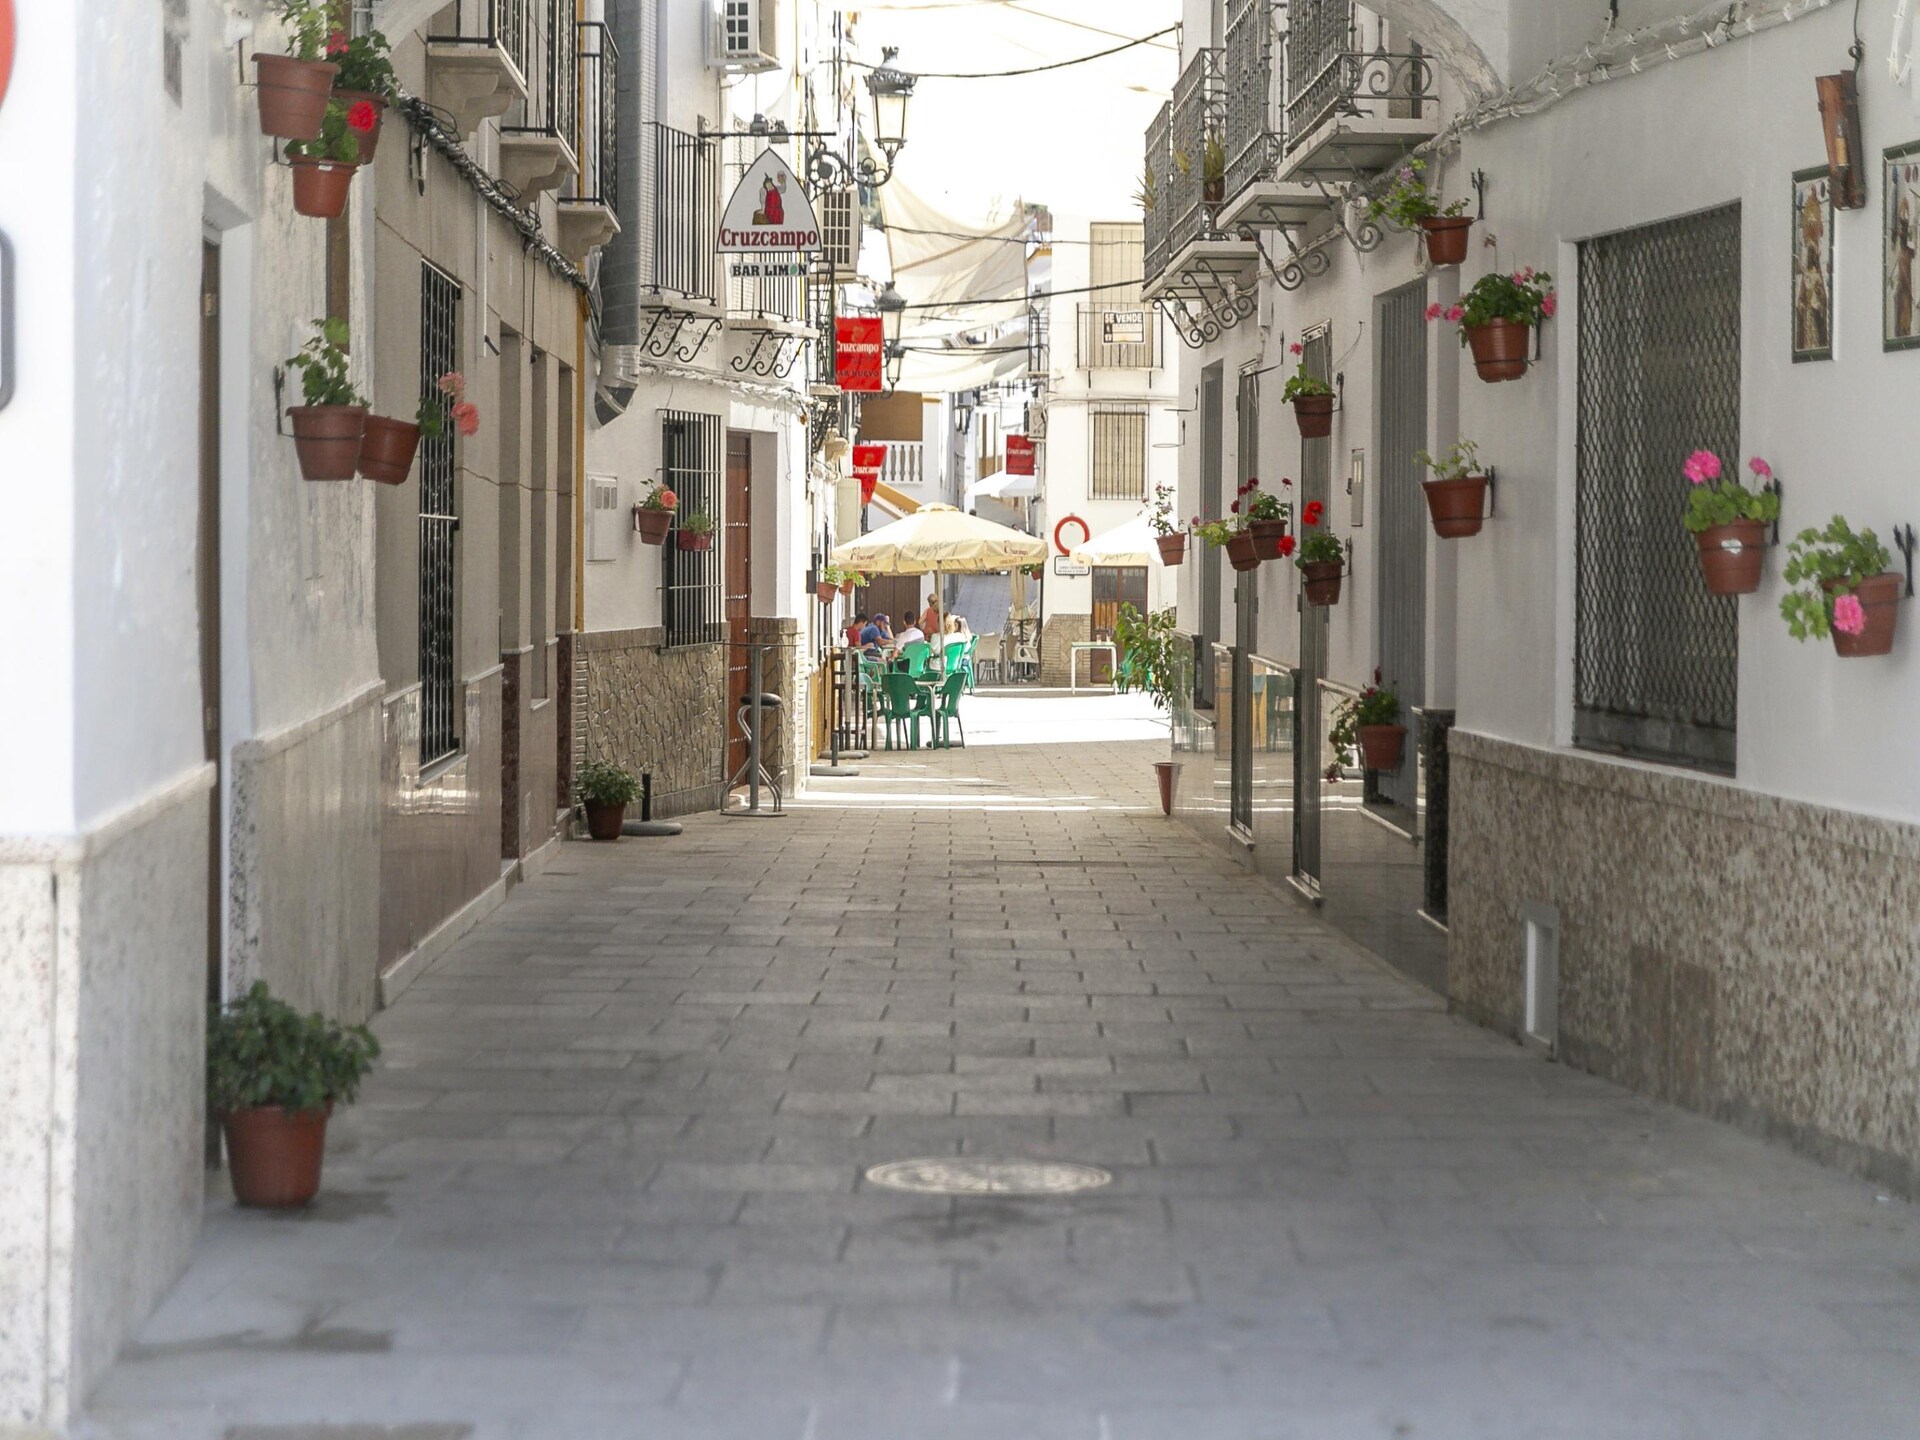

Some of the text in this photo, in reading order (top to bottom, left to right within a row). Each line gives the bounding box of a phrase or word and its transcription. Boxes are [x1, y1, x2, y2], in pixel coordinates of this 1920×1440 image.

[721, 228, 817, 250] Cruzcampo
[732, 264, 760, 276] BAR
[1104, 313, 1142, 324] SE VENDE
